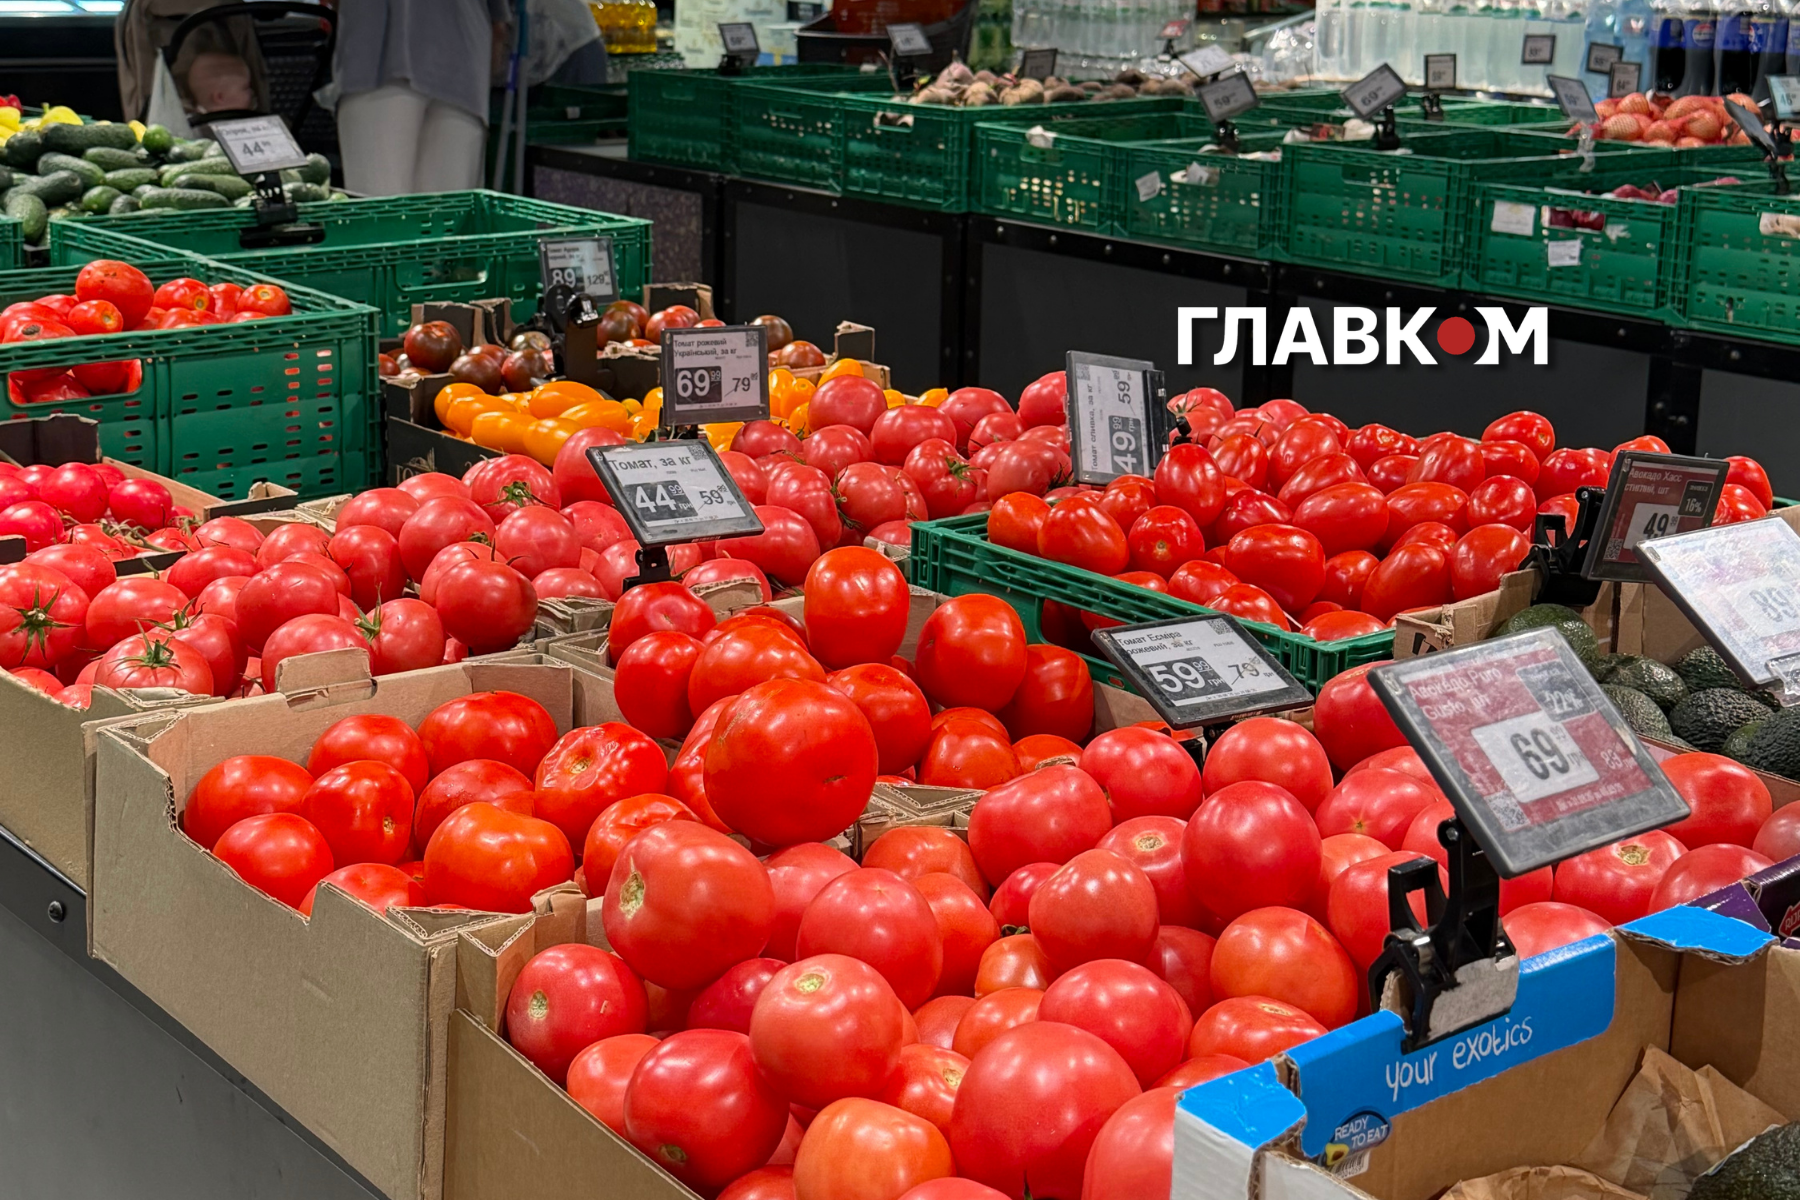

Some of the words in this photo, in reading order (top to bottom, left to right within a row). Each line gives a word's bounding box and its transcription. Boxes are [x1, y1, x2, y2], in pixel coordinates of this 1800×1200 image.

[242, 140, 265, 157] 44
[552, 268, 577, 289] 89
[587, 274, 605, 286] 129
[674, 340, 695, 348] Томат
[697, 338, 727, 348] рожевий
[674, 348, 719, 358] Український,
[677, 369, 711, 398] 69
[732, 377, 751, 392] 79
[1087, 384, 1093, 392] кг
[1088, 395, 1094, 406] за
[1117, 381, 1131, 405] 59
[1089, 408, 1097, 442] сливка,
[1128, 417, 1136, 432] грн
[1112, 431, 1137, 474] 49
[608, 459, 657, 471] Томат,
[660, 456, 676, 467] за
[680, 456, 692, 465] кг
[1628, 467, 1662, 481] Авокадо
[1662, 471, 1683, 482] Хасс
[635, 484, 677, 513] 44
[668, 485, 684, 496] 99
[699, 490, 724, 505] 59
[1657, 486, 1670, 495] шт
[679, 502, 694, 511] грн
[1685, 498, 1702, 513] 16%
[1749, 587, 1798, 622] 89
[1117, 636, 1147, 646] Томат
[1147, 631, 1182, 641] Есміра
[1148, 662, 1206, 693] 59
[1192, 660, 1211, 671] 99
[1228, 662, 1260, 679] 79
[1468, 667, 1504, 687] Puro
[1208, 679, 1225, 687] грн
[1510, 727, 1570, 780] 69
[1385, 1051, 1438, 1103] your
[1452, 1015, 1533, 1070] exotics
[1334, 1115, 1369, 1141] READY
[1351, 1132, 1366, 1149] TO
[1367, 1124, 1389, 1143] EAT
